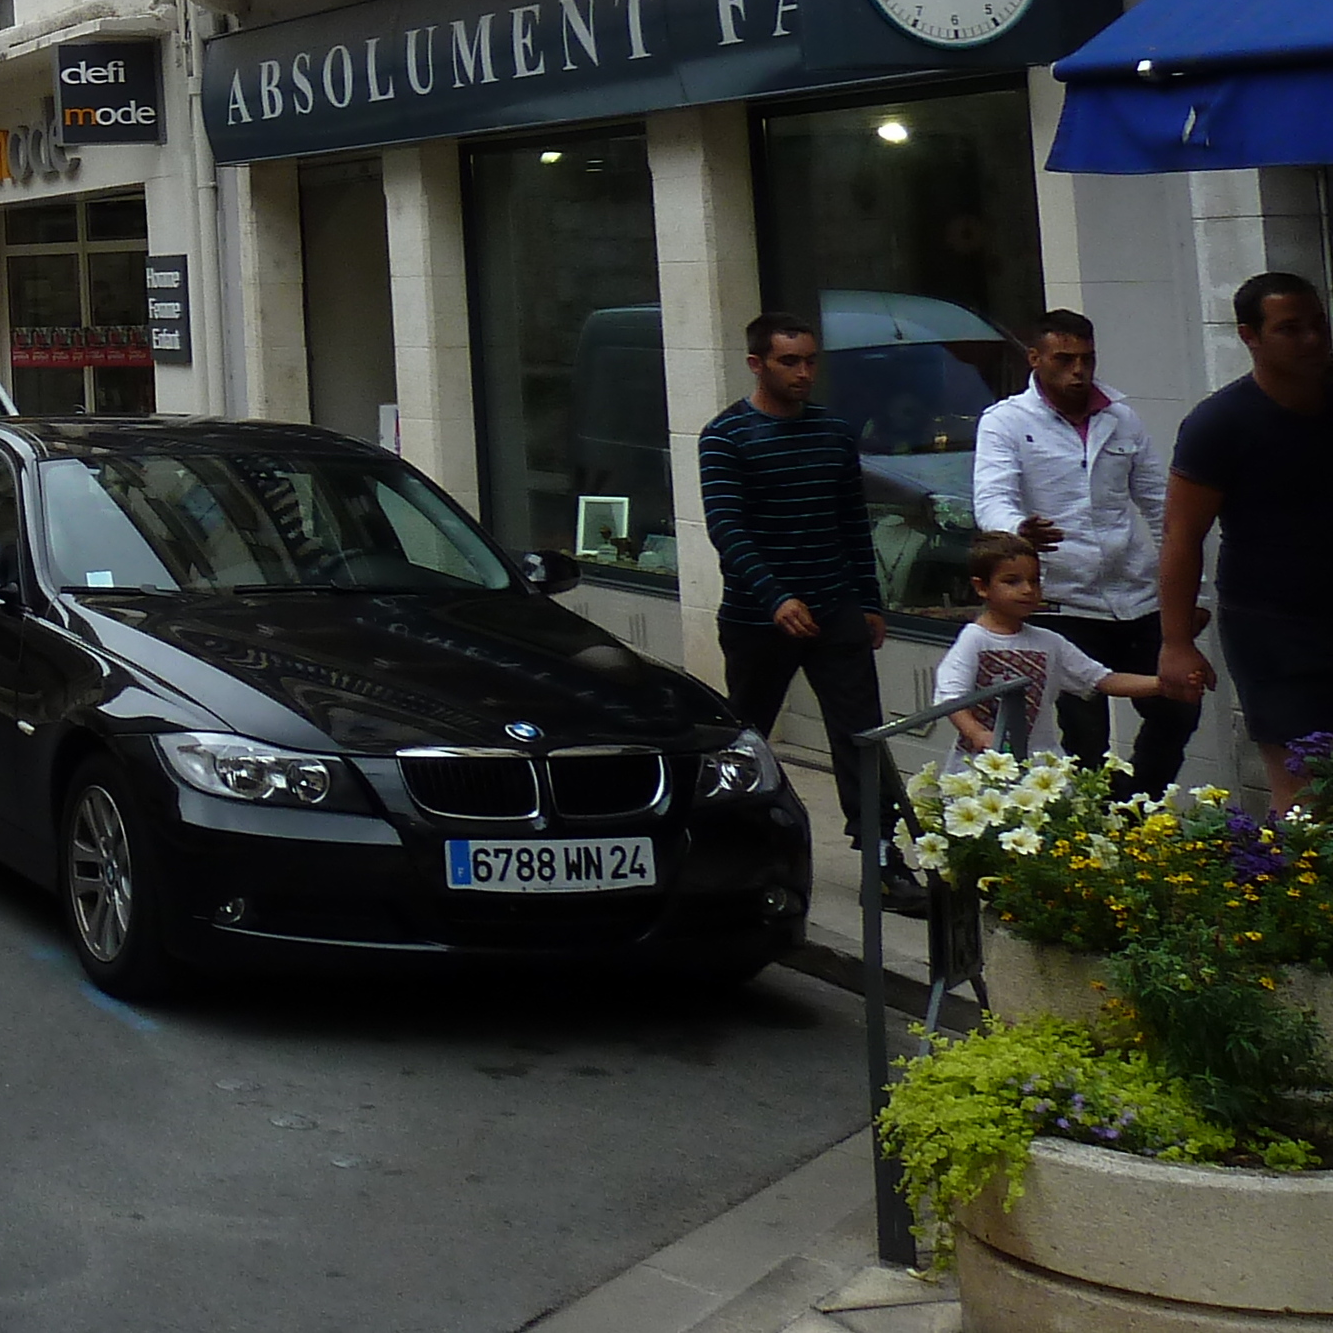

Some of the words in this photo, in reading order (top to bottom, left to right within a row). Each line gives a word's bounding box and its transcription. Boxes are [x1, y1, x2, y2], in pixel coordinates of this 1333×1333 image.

[916, 6, 923, 16] 7
[985, 4, 992, 15] 5
[951, 15, 959, 25] 6
[61, 60, 126, 85] defi
[64, 100, 156, 126] mode
[473, 847, 556, 882] 6788
[564, 846, 603, 881] WN
[610, 845, 647, 880] 24
